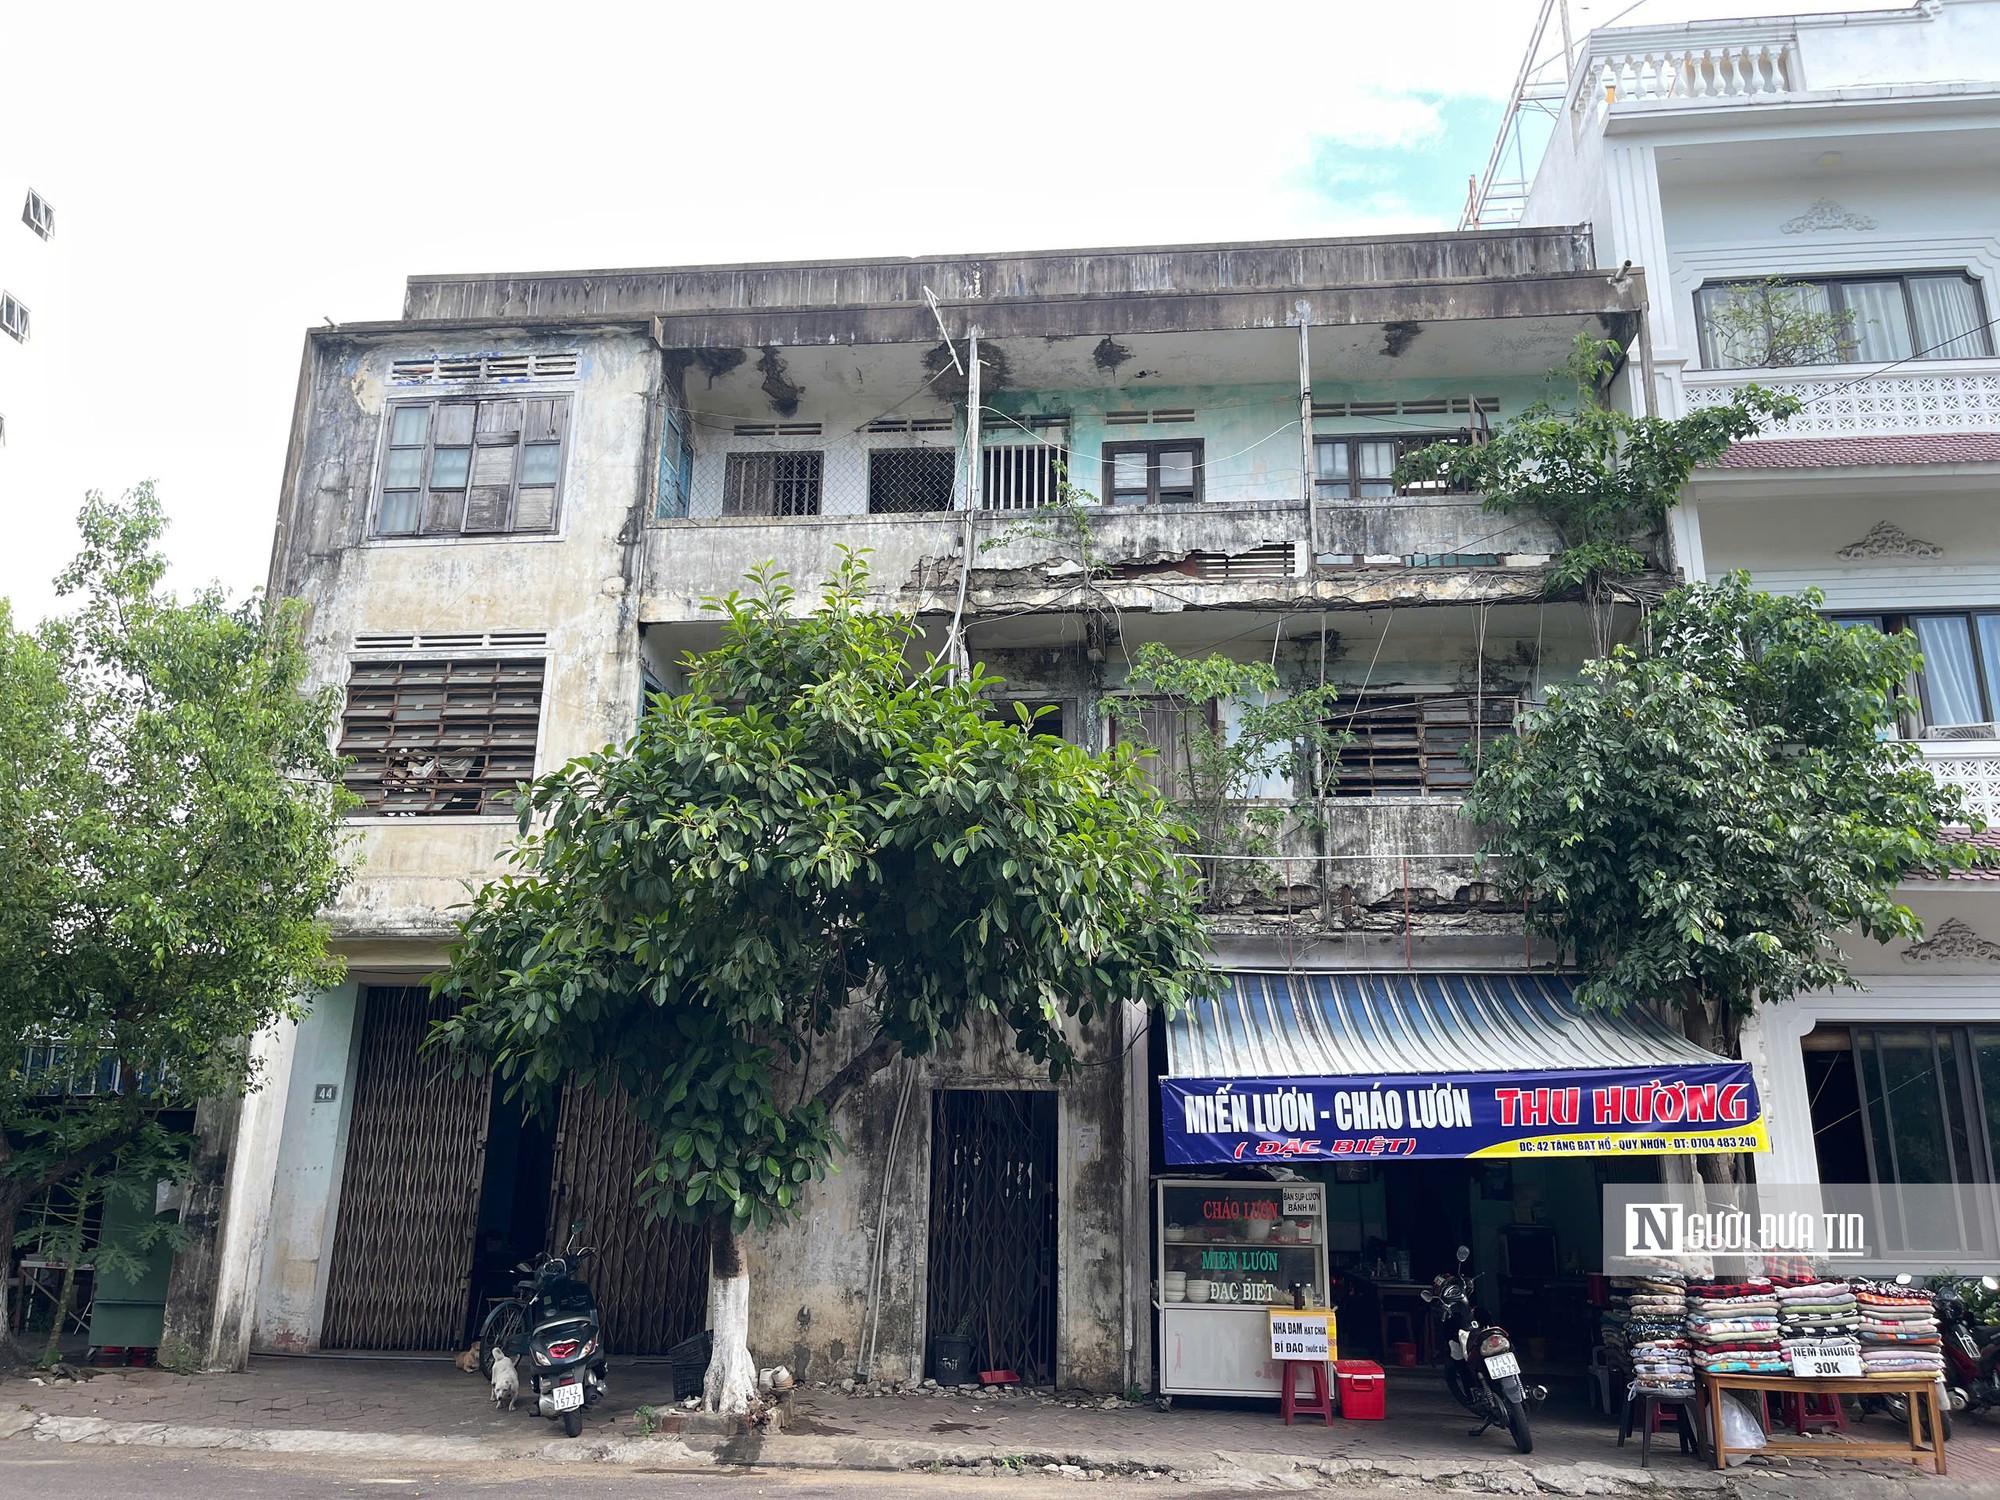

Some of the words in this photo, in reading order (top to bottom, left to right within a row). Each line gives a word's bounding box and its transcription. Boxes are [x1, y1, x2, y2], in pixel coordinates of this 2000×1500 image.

[319, 1087, 333, 1099] 44
[1184, 1083, 1249, 1134] MIẾN
[1252, 1086, 1316, 1132] LƯƠN
[1334, 1082, 1404, 1131] CHÁO
[1406, 1082, 1472, 1129] LƯƠN
[1494, 1087, 1581, 1126] THU
[1592, 1079, 1750, 1125] HƯƠNG
[1537, 1141, 1549, 1151] 42
[1577, 1140, 1596, 1152] BẠT
[1619, 1139, 1638, 1150] QUY
[1690, 1138, 1715, 1148] 0704
[1717, 1137, 1736, 1147] 483
[1739, 1136, 1757, 1147] 240
[1203, 1196, 1240, 1220] CHÁO
[1819, 1346, 1855, 1357] NHUNG
[1814, 1361, 1841, 1374] 30K
